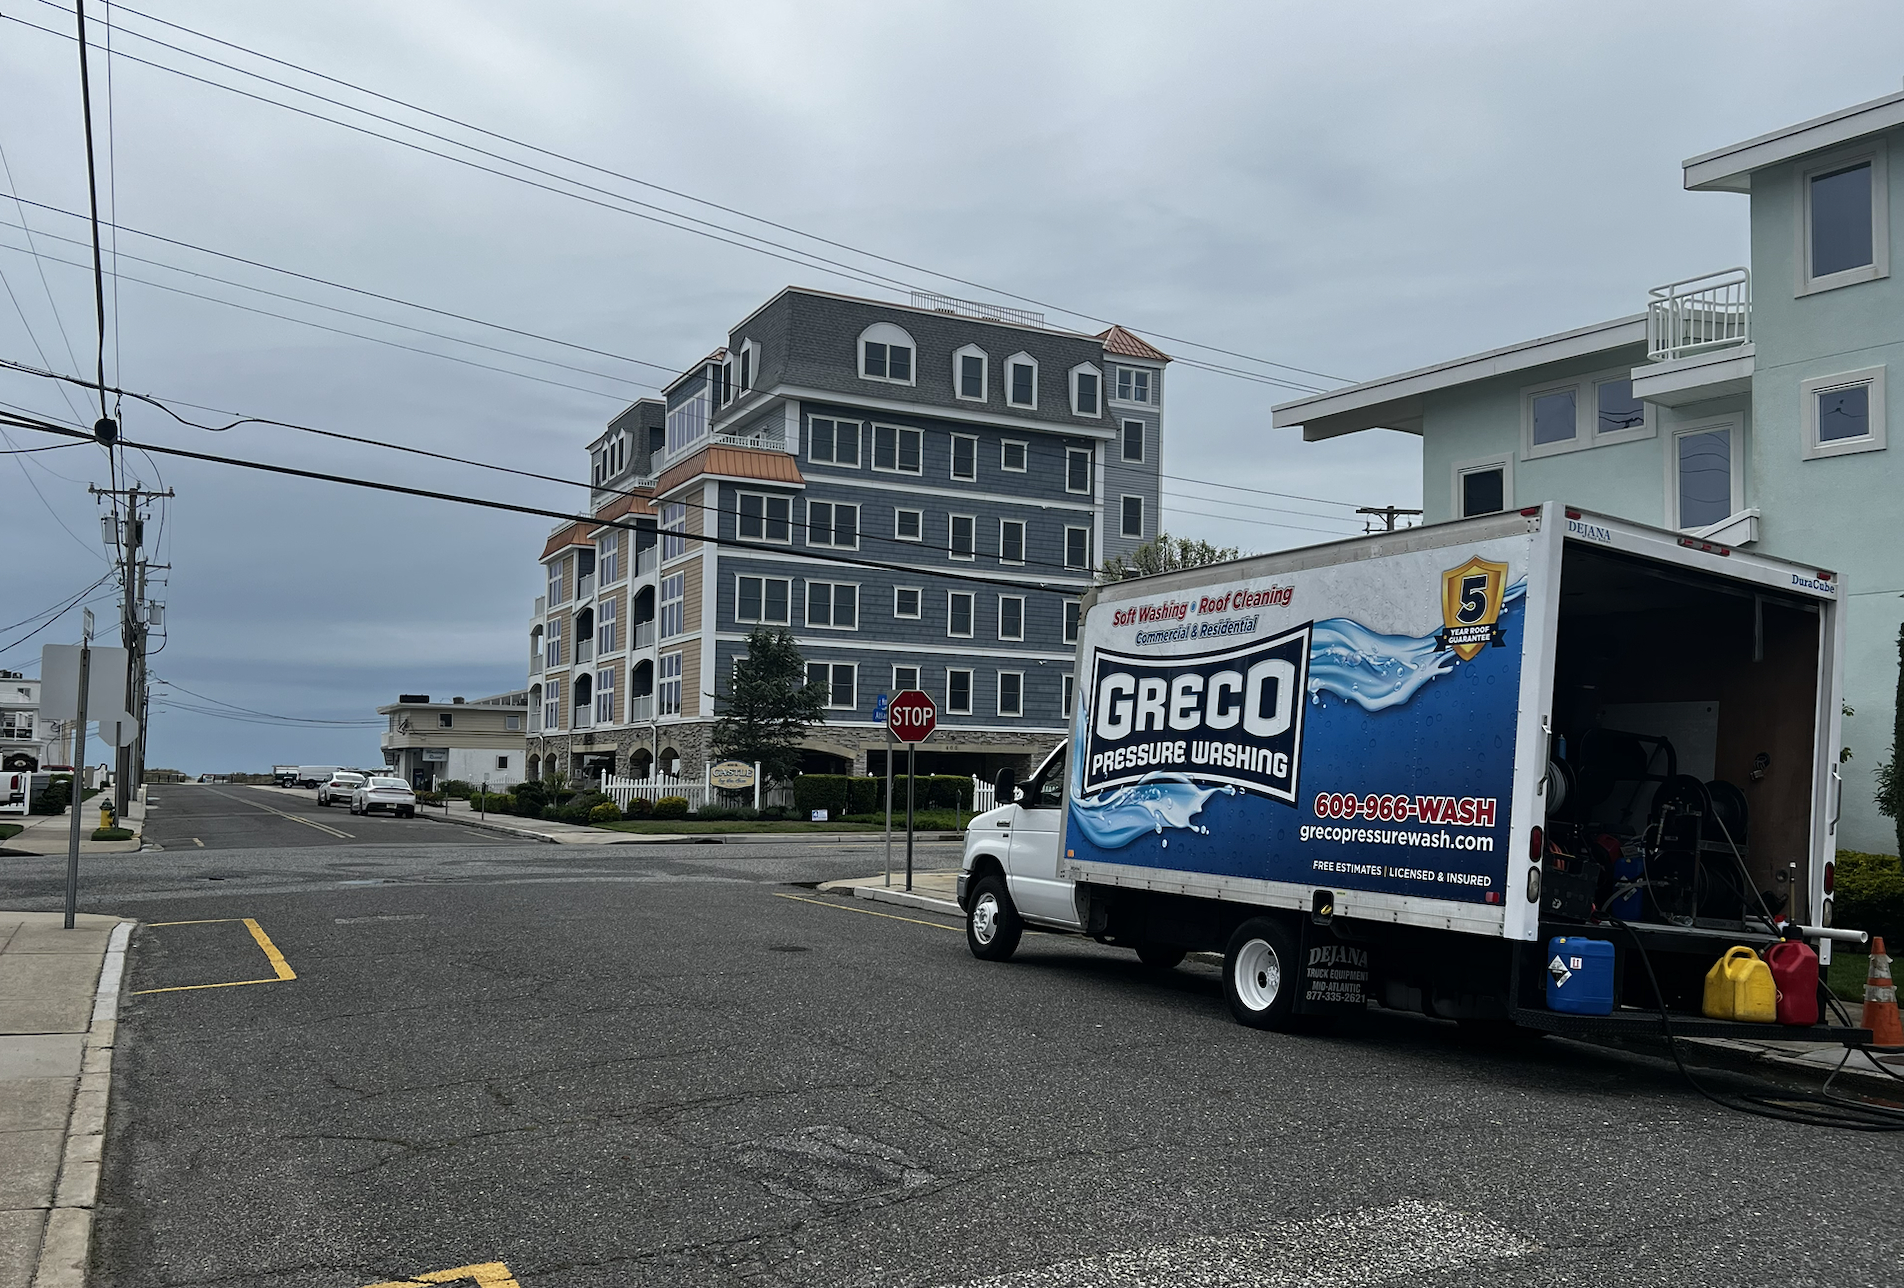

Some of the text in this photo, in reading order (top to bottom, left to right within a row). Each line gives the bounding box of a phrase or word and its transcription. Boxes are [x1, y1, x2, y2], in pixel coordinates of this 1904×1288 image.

[1568, 520, 1611, 540] DEJANA
[1791, 574, 1835, 593] DuraCube
[1113, 584, 1295, 627] Soft Washing Roof Cleaning
[1455, 573, 1488, 625] 5
[1135, 615, 1259, 646] Commercial & Residential
[1448, 633, 1491, 644] GUARANTEE
[1450, 626, 1490, 636] YEAR ROOF
[1096, 658, 1296, 740] GRECO
[892, 706, 934, 726] STOP
[1092, 740, 1289, 778] PRESSURE WASHING
[713, 769, 753, 777] CASTLE
[1314, 792, 1496, 827] 609-966-WASH
[1300, 824, 1494, 852] grecopressurewash.com
[1313, 860, 1491, 887] FREE ESTIMATES LICENSED & INSURED
[1308, 945, 1369, 968] DEJANA
[1306, 967, 1369, 981] TRUCK EQUIPMENT
[1305, 991, 1366, 1003] 877-335-2621
[1312, 981, 1361, 993] MID-ATLANTIC
